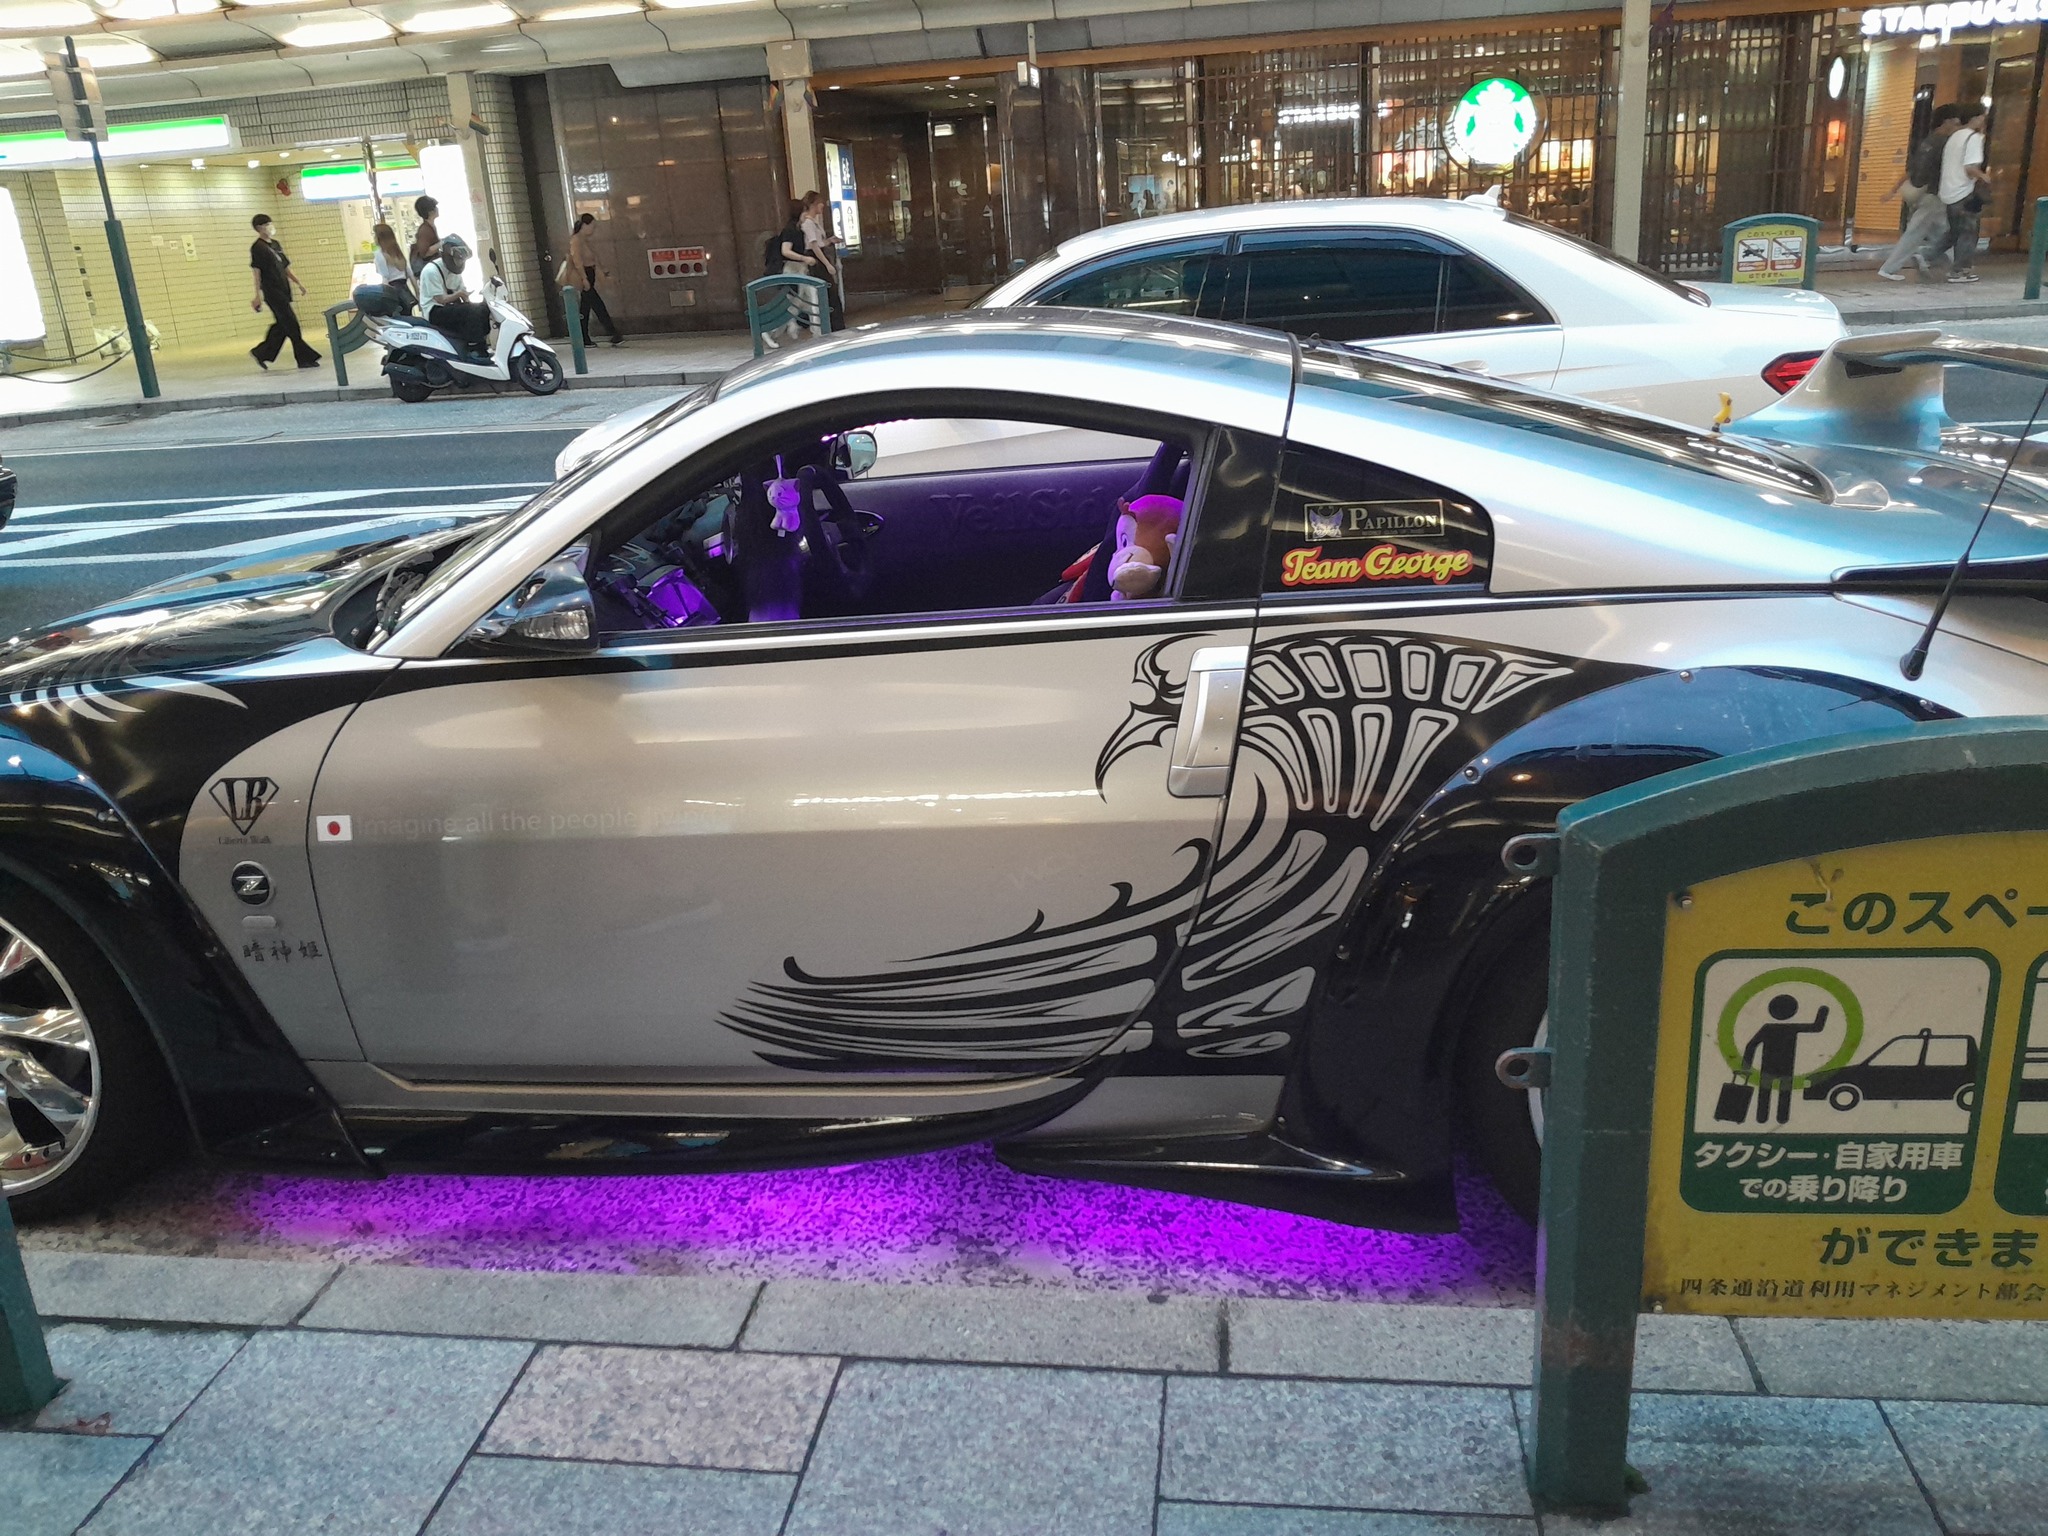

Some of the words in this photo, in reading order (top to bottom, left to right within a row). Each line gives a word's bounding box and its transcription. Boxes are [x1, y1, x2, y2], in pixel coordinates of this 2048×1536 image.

[929, 486, 1108, 532] VeilSid
[1283, 547, 1362, 583] Team
[1364, 546, 1470, 581] George
[465, 811, 494, 833] all
[501, 809, 541, 832] the
[549, 806, 638, 835] people
[1739, 1174, 1909, 1203] での乗り降り
[1819, 1226, 2039, 1268] ができま
